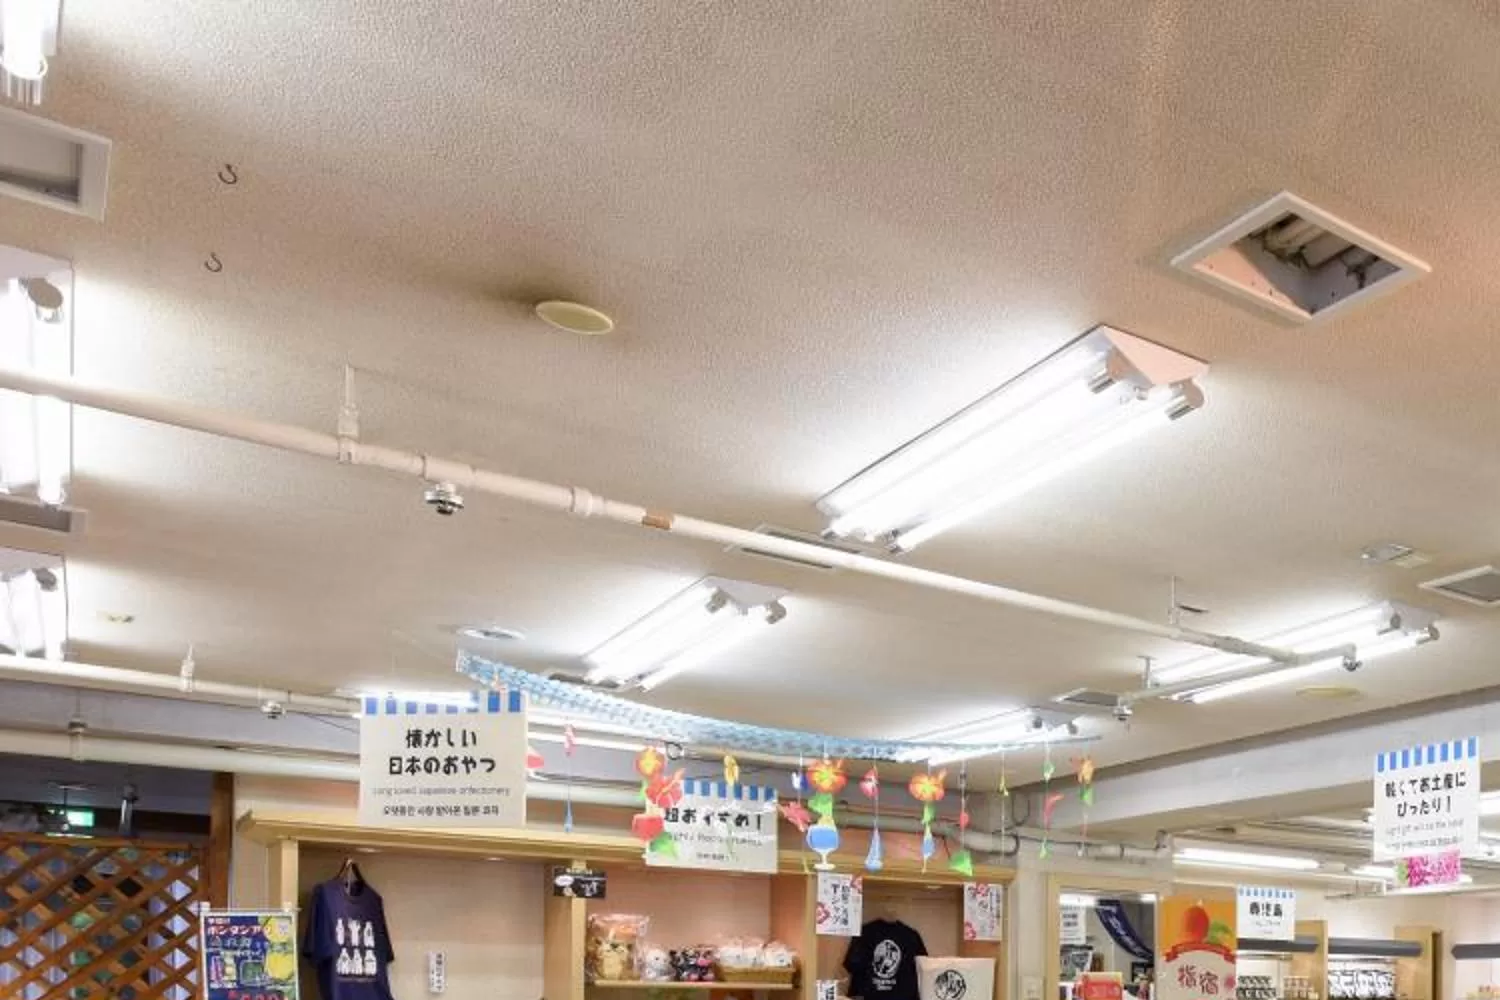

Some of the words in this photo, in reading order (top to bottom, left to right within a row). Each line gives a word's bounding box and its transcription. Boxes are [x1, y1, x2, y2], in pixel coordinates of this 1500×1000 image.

[405, 728, 478, 749] 懐かしい
[388, 755, 497, 776] 日本のおやつ
[1385, 771, 1467, 798] 軽くてお土産に
[1177, 964, 1219, 995] 指宿
